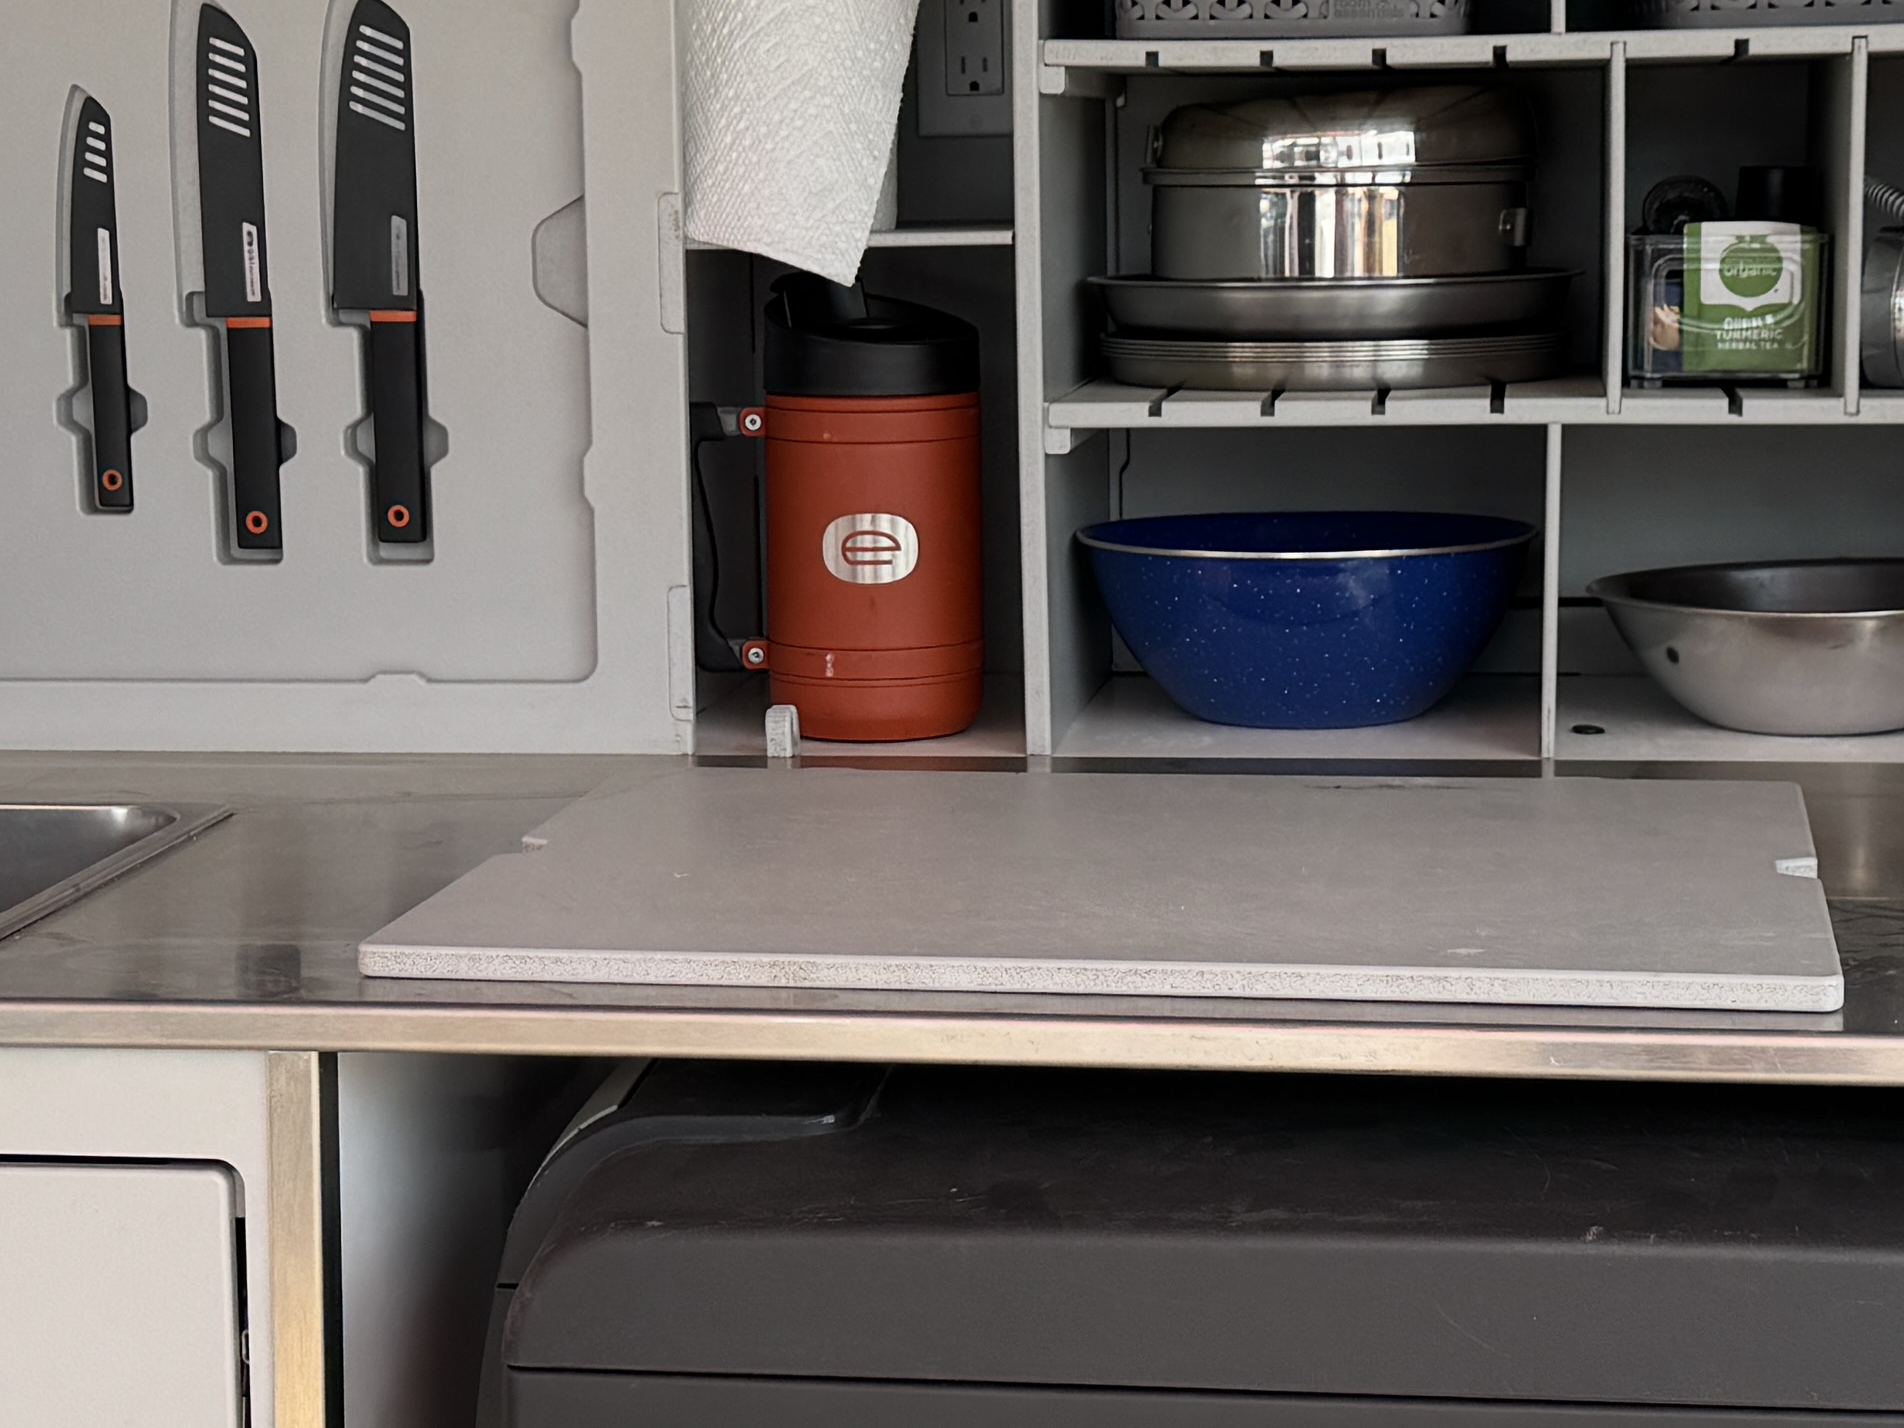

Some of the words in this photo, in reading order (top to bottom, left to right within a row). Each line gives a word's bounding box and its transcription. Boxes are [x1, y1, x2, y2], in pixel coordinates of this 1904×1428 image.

[1723, 261, 1778, 278] organic
[1717, 329, 1783, 340] TURMERIC
[1760, 341, 1778, 349] TEA
